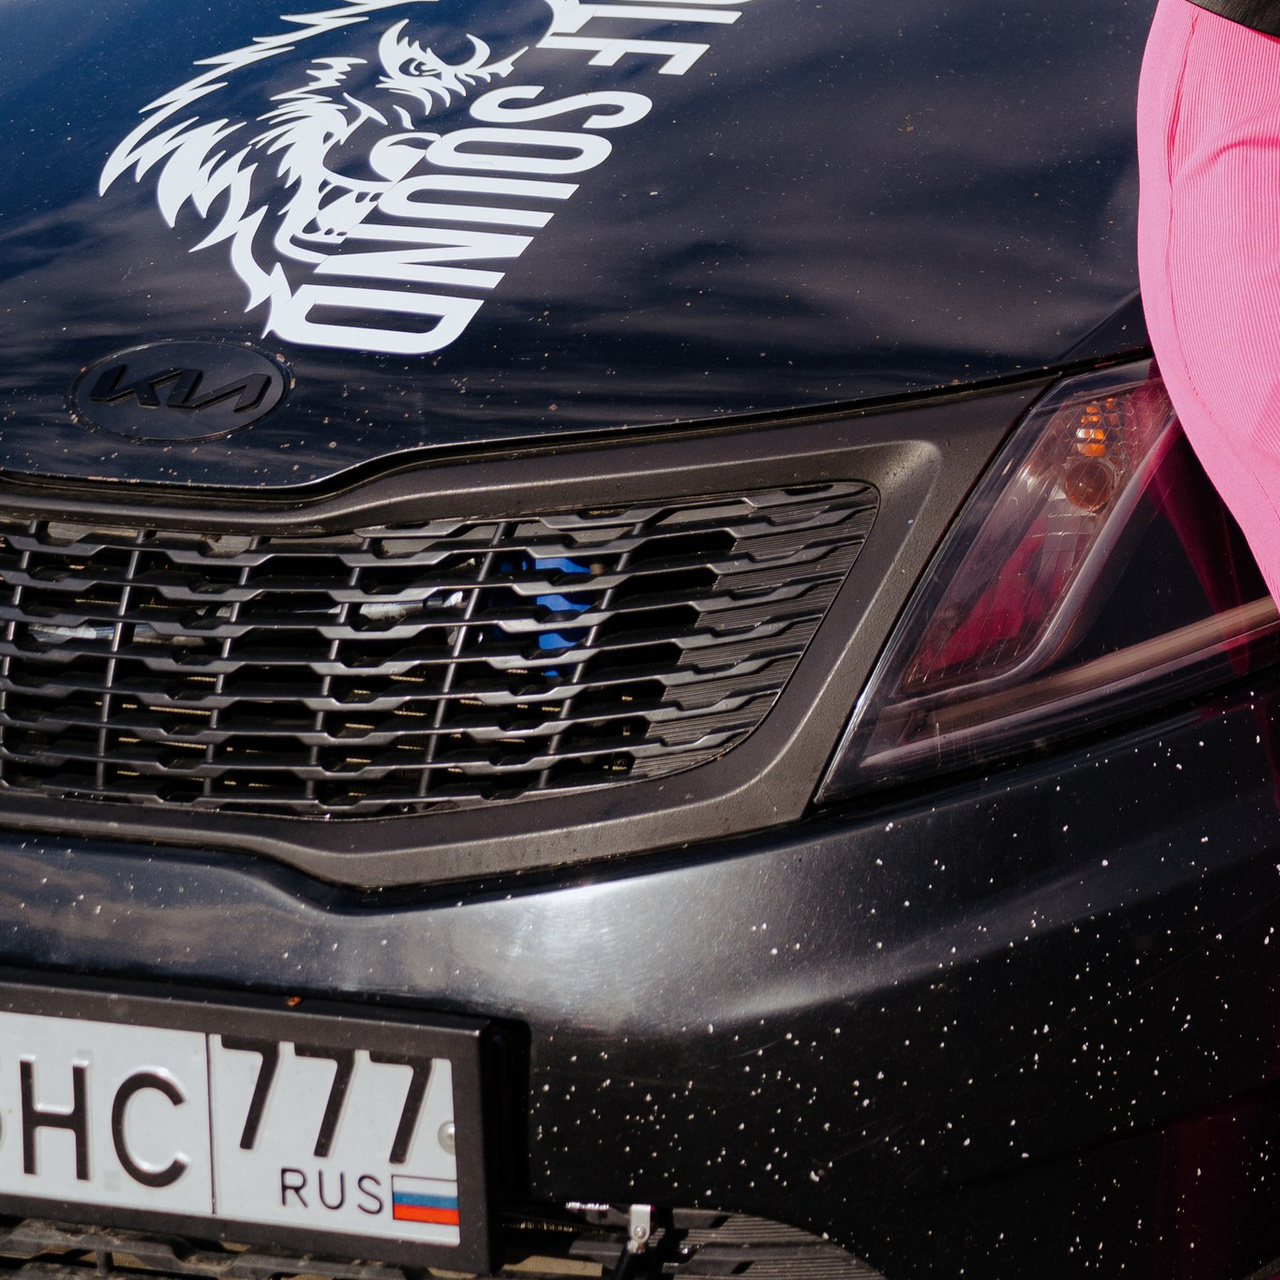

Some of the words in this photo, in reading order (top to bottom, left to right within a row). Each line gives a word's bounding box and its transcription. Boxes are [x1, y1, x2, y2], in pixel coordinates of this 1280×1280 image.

[271, 84, 653, 355] SOUND
[90, 363, 272, 413] KIA
[0, 1057, 189, 1188] HC
[221, 1032, 434, 1165] 777
[280, 1167, 385, 1215] RUS
